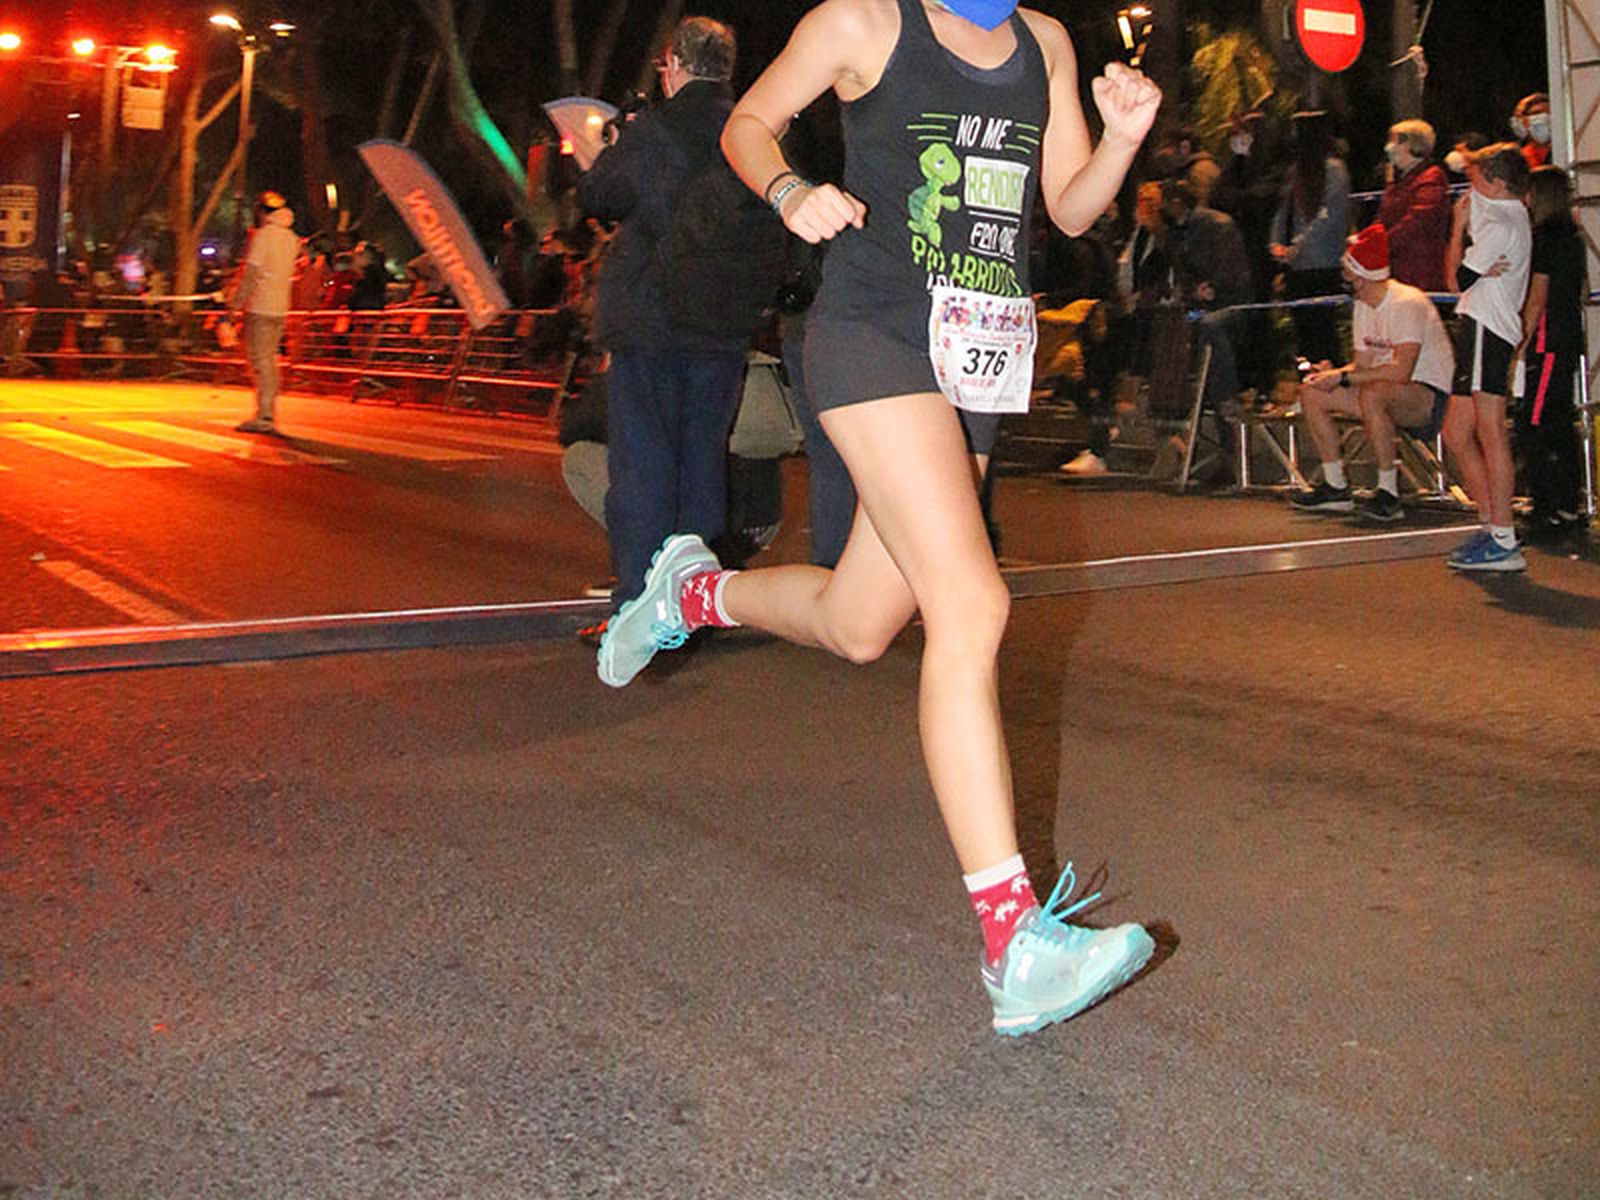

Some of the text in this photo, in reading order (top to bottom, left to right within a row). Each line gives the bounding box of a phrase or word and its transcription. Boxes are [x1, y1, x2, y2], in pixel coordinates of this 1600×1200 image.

[955, 114, 1013, 150] NO ME
[961, 347, 1009, 377] 376
